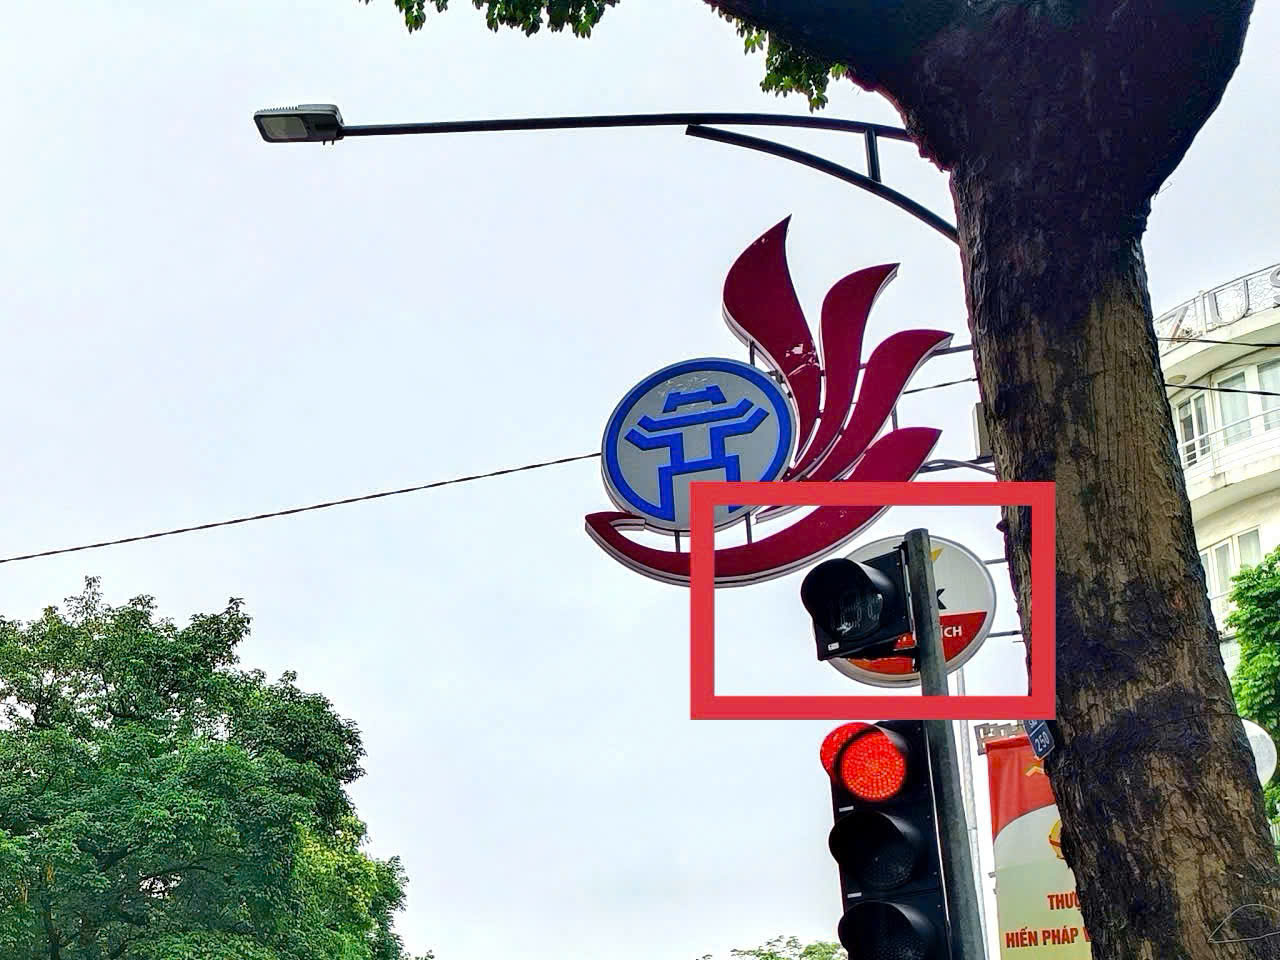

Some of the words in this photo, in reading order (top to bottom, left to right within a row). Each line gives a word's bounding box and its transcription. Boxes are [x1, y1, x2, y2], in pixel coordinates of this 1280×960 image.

[1034, 731, 1050, 752] 250
[1005, 926, 1039, 948] HIẾN
[1042, 925, 1079, 945] PHÁP
